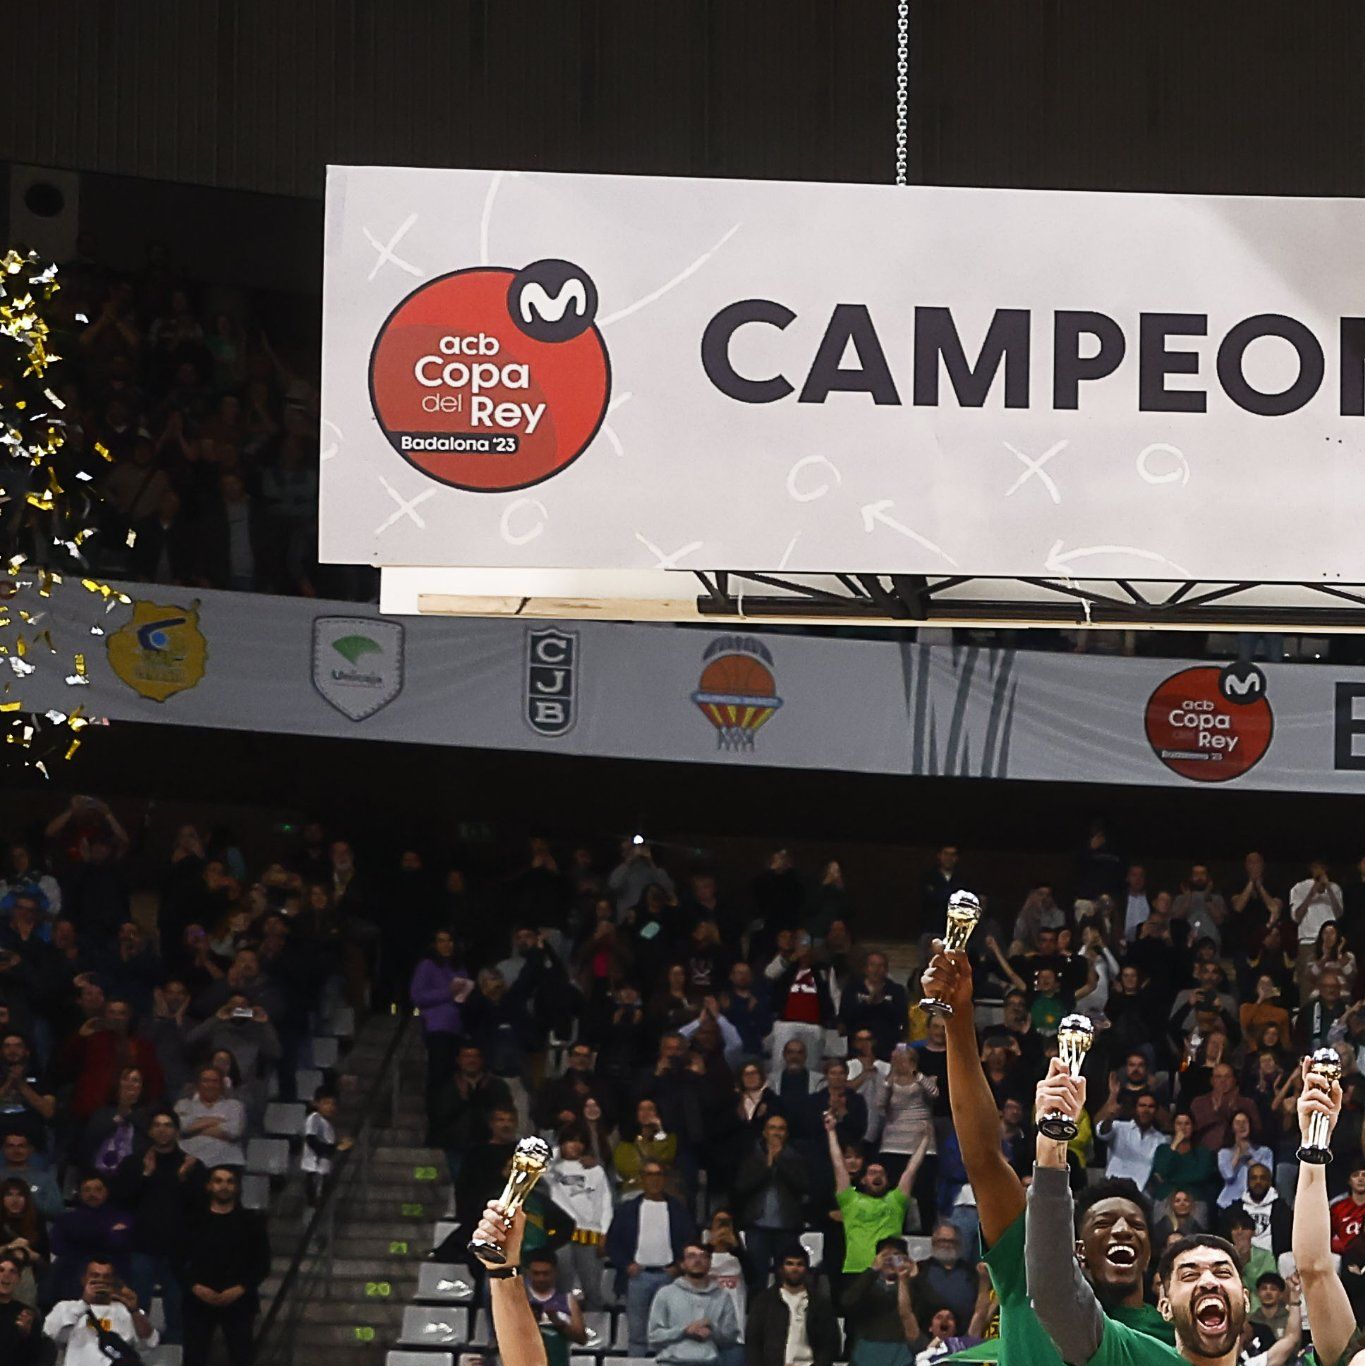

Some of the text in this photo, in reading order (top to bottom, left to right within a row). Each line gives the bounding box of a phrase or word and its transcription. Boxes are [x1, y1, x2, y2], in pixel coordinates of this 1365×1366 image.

[439, 333, 500, 355] acb
[414, 355, 530, 394] Copa
[421, 393, 546, 434] del Rey
[401, 436, 517, 452] Badalona '23
[1182, 700, 1215, 711] acb
[1168, 710, 1231, 731] Copa
[1198, 731, 1239, 752] Rey
